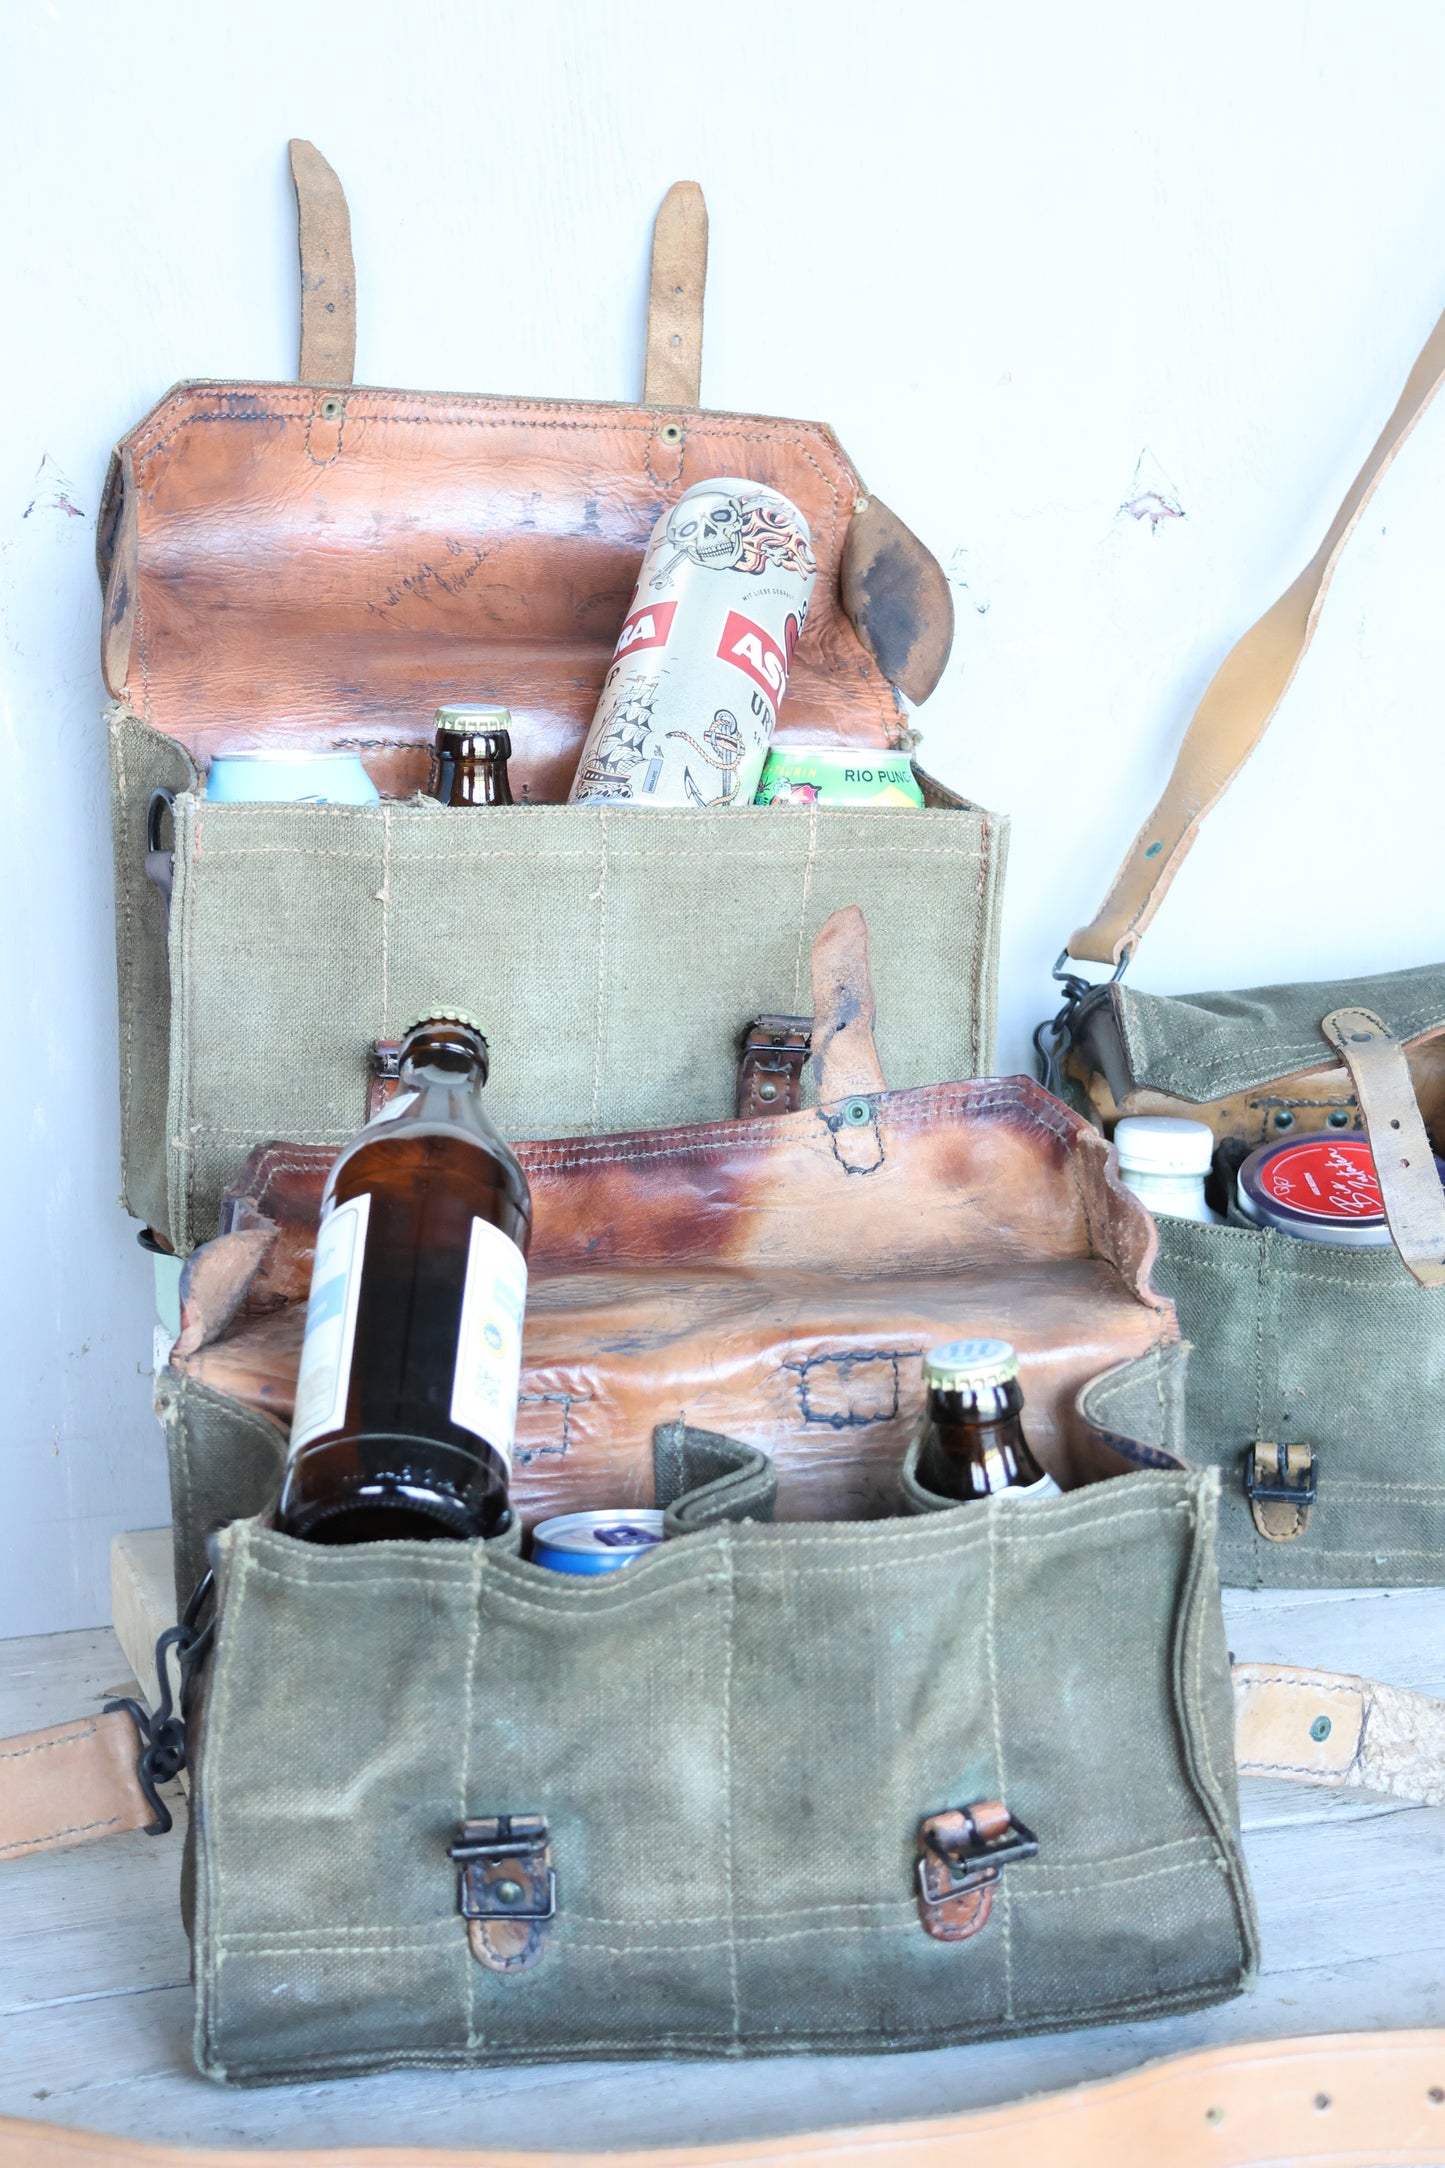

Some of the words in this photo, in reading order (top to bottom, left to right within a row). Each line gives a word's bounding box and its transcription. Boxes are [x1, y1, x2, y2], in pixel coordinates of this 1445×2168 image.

[742, 591, 753, 601] MIT
[753, 587, 771, 597] LIEBE
[751, 690, 773, 733] UR
[845, 769, 873, 782] RIO
[878, 770, 911, 783] PUNC
